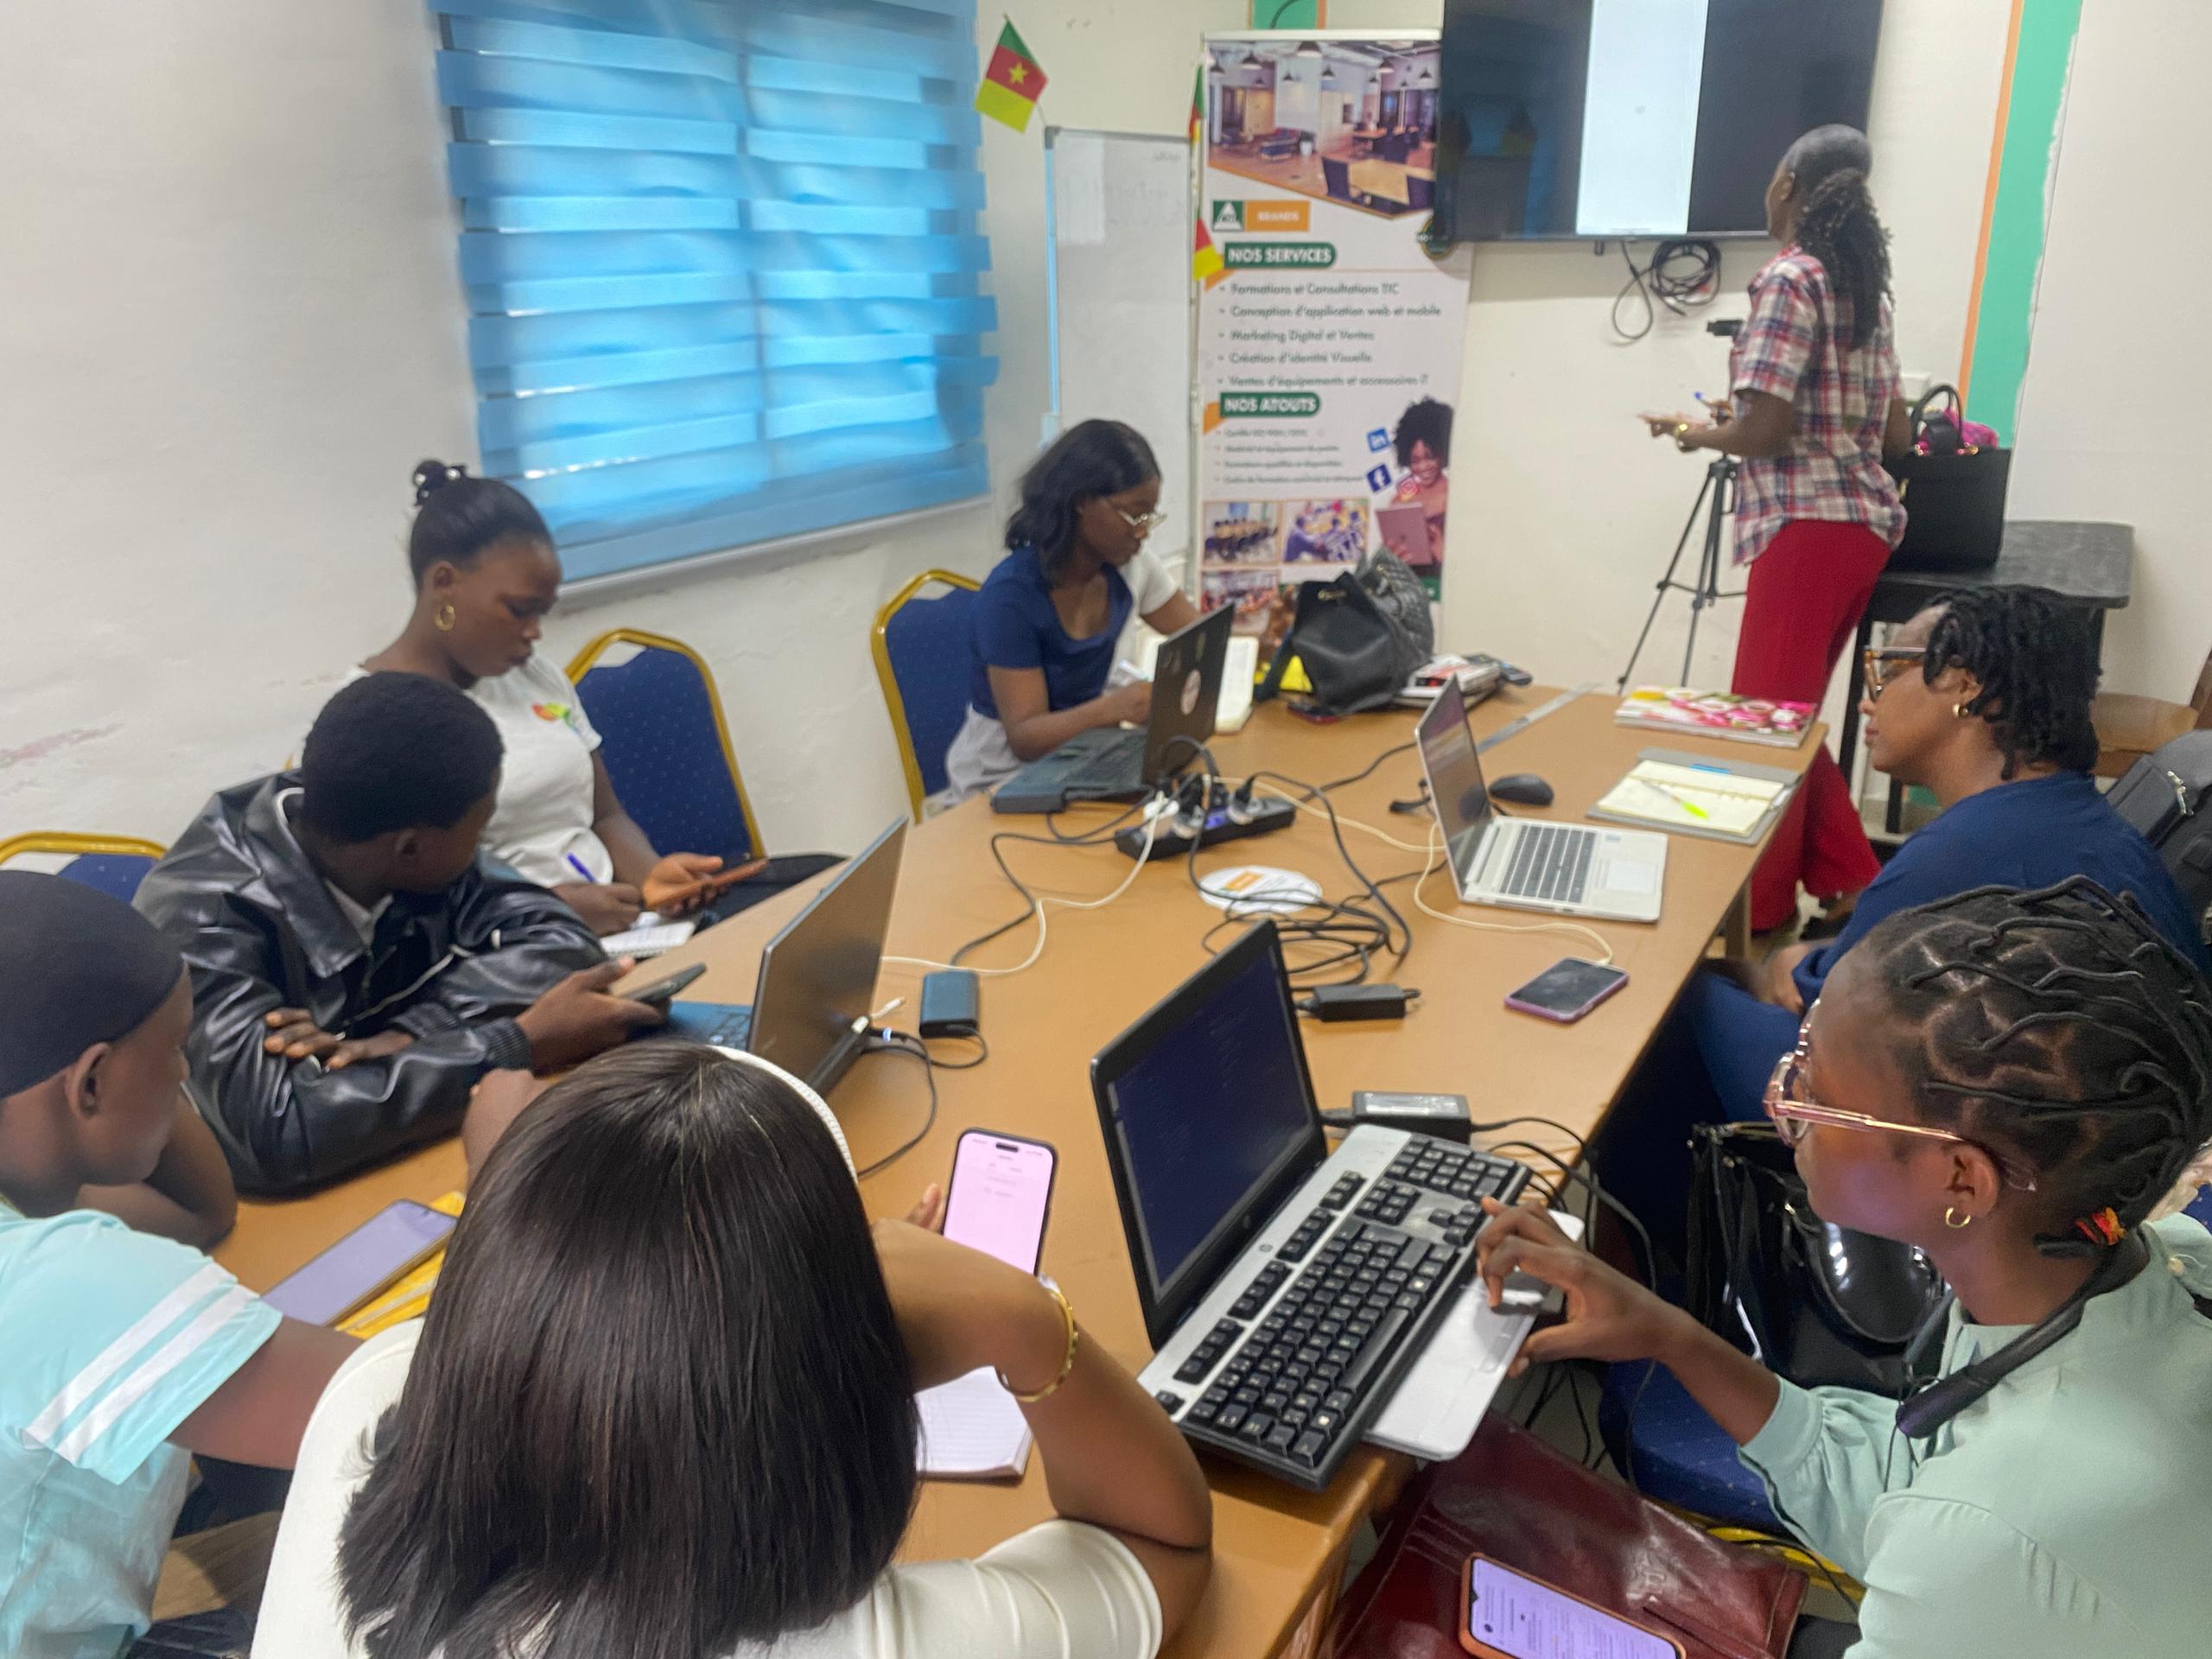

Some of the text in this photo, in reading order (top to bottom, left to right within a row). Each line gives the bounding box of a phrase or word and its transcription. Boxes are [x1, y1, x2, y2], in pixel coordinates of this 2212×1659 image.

[1228, 247, 1332, 263] NOS SERVICES
[1306, 282, 1379, 295] Consultations
[1230, 304, 1294, 320] Conception
[1367, 305, 1390, 316] web
[1407, 303, 1440, 316] mobile
[1230, 330, 1287, 343] Marketing
[1288, 329, 1325, 343] Digital
[1224, 397, 1317, 412] NOS ATOUTS
